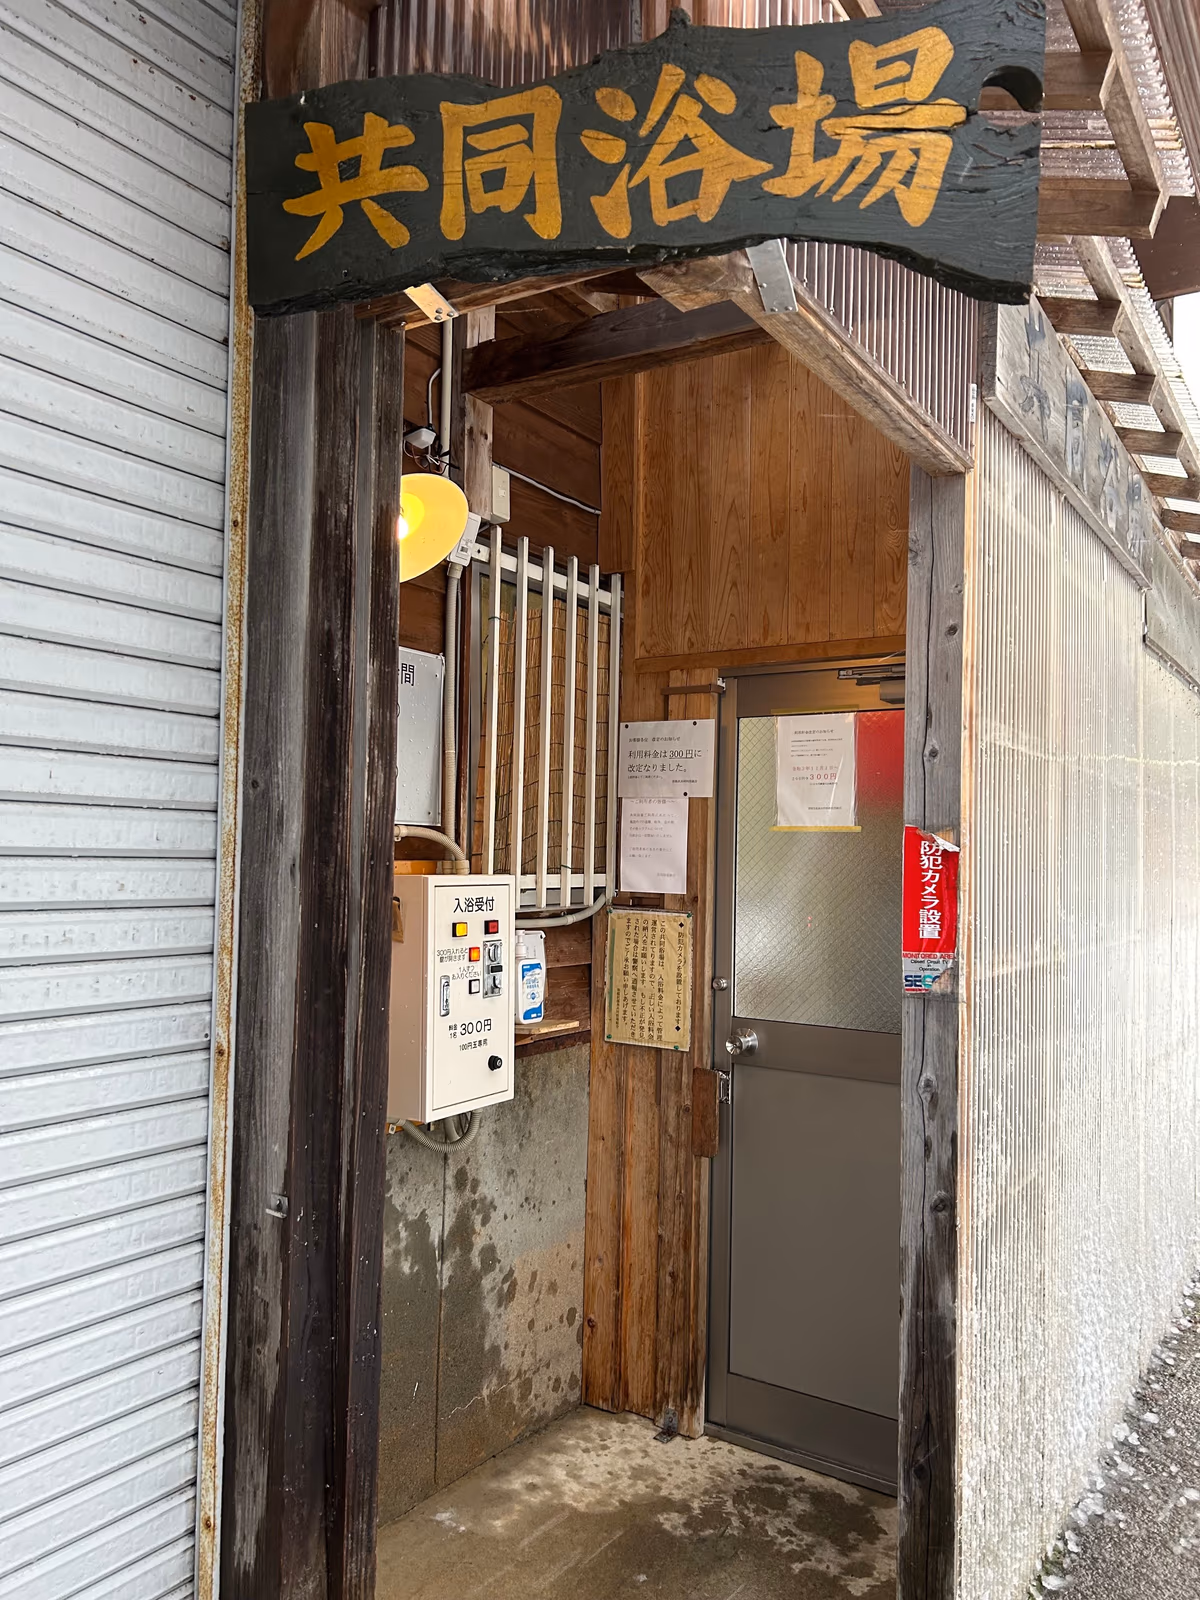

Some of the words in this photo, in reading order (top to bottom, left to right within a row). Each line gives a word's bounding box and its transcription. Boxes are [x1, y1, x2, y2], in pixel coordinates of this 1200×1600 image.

[282, 26, 968, 262] 共同浴場
[397, 663, 414, 686] 間
[628, 749, 702, 760] 利用料金は300円に
[628, 763, 687, 773] 改定なりました。
[919, 840, 943, 939] 防犯カメラ設置
[453, 896, 495, 913] 入浴受付
[459, 1018, 492, 1036] 300円
[459, 1038, 488, 1051] 100円玉専用
